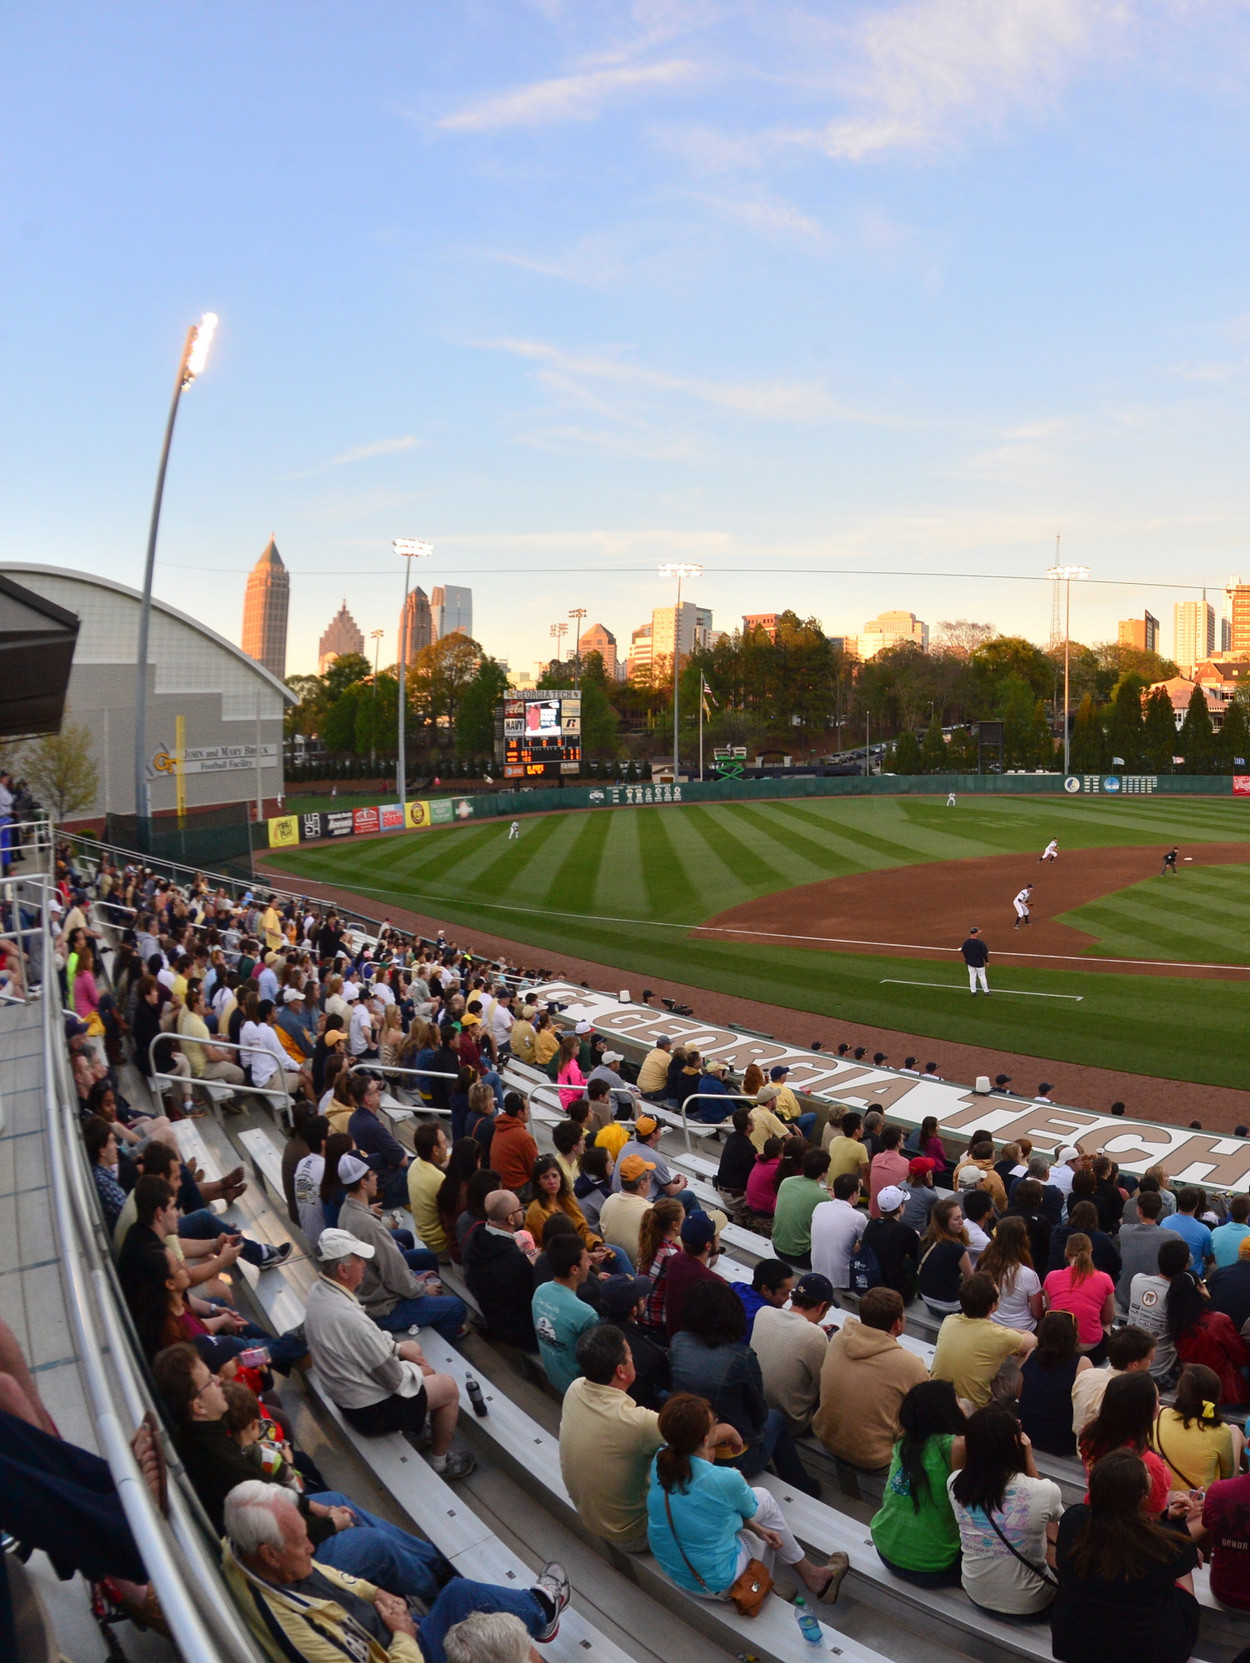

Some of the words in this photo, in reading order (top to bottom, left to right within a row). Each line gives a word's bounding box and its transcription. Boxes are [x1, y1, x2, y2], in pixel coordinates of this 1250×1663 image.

[516, 690, 551, 699] GEORGIA
[551, 690, 572, 699] TECH
[506, 719, 523, 730] NAVY
[184, 749, 204, 759] JOHN
[206, 749, 218, 757] and
[220, 747, 242, 757] MARY
[200, 760, 227, 771] Football
[228, 759, 253, 769] Facility
[592, 1008, 921, 1110] GEORGIA
[1221, 1538, 1249, 1550] HONOR
